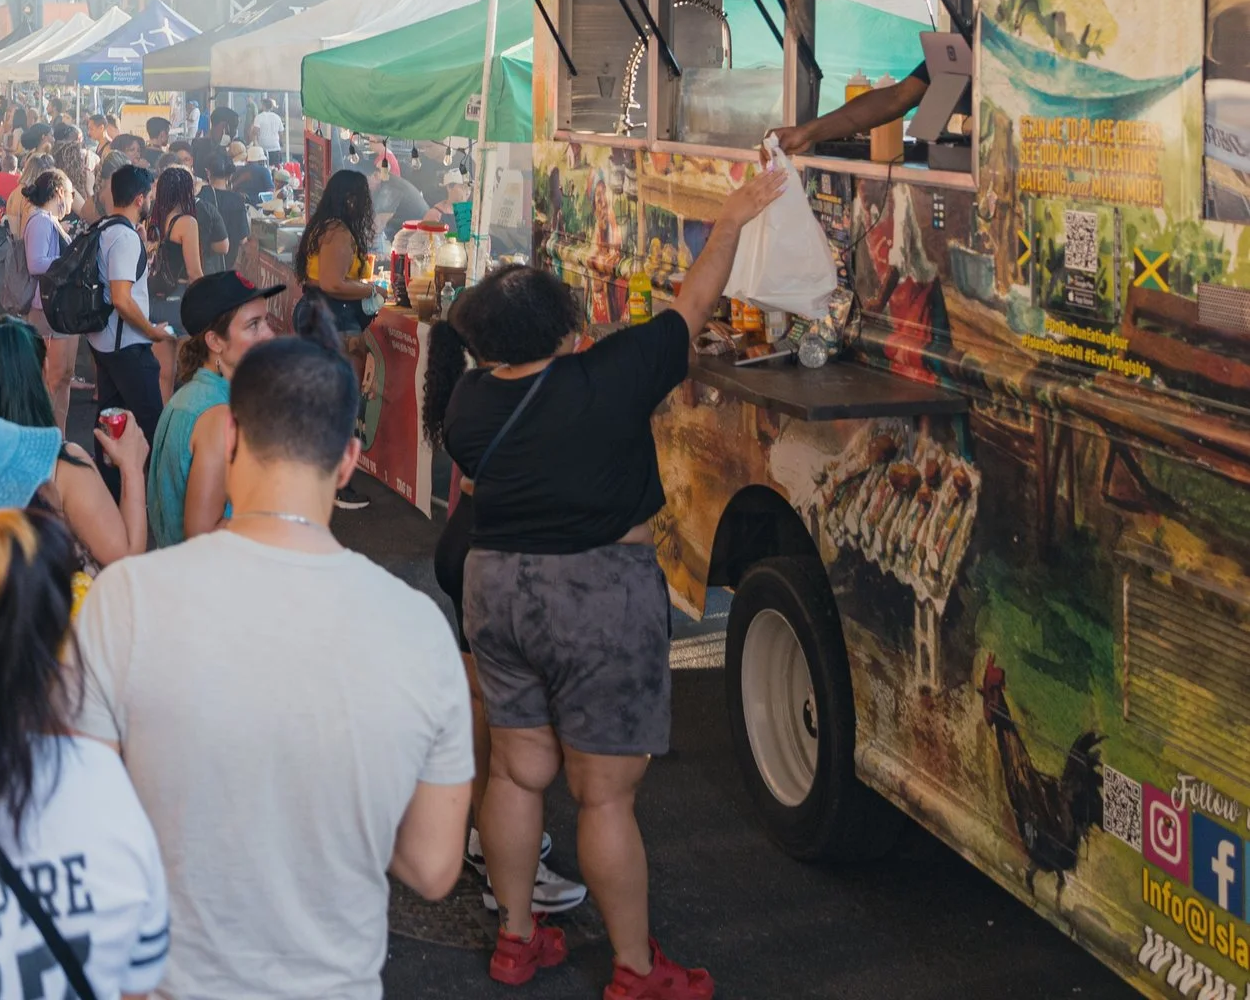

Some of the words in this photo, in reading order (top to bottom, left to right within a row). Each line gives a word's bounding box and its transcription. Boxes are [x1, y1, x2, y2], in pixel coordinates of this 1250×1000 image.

[1020, 115, 1045, 139] SCAN
[1047, 117, 1063, 139] ME
[1067, 117, 1078, 141] TO
[1080, 118, 1114, 143] PLACE
[1020, 141, 1037, 164] SEE
[1039, 143, 1059, 166] OUR
[1019, 168, 1067, 193] CATERING
[1092, 176, 1123, 199] MUCH
[1125, 178, 1163, 205] MORE!
[1171, 773, 1241, 822] Follow
